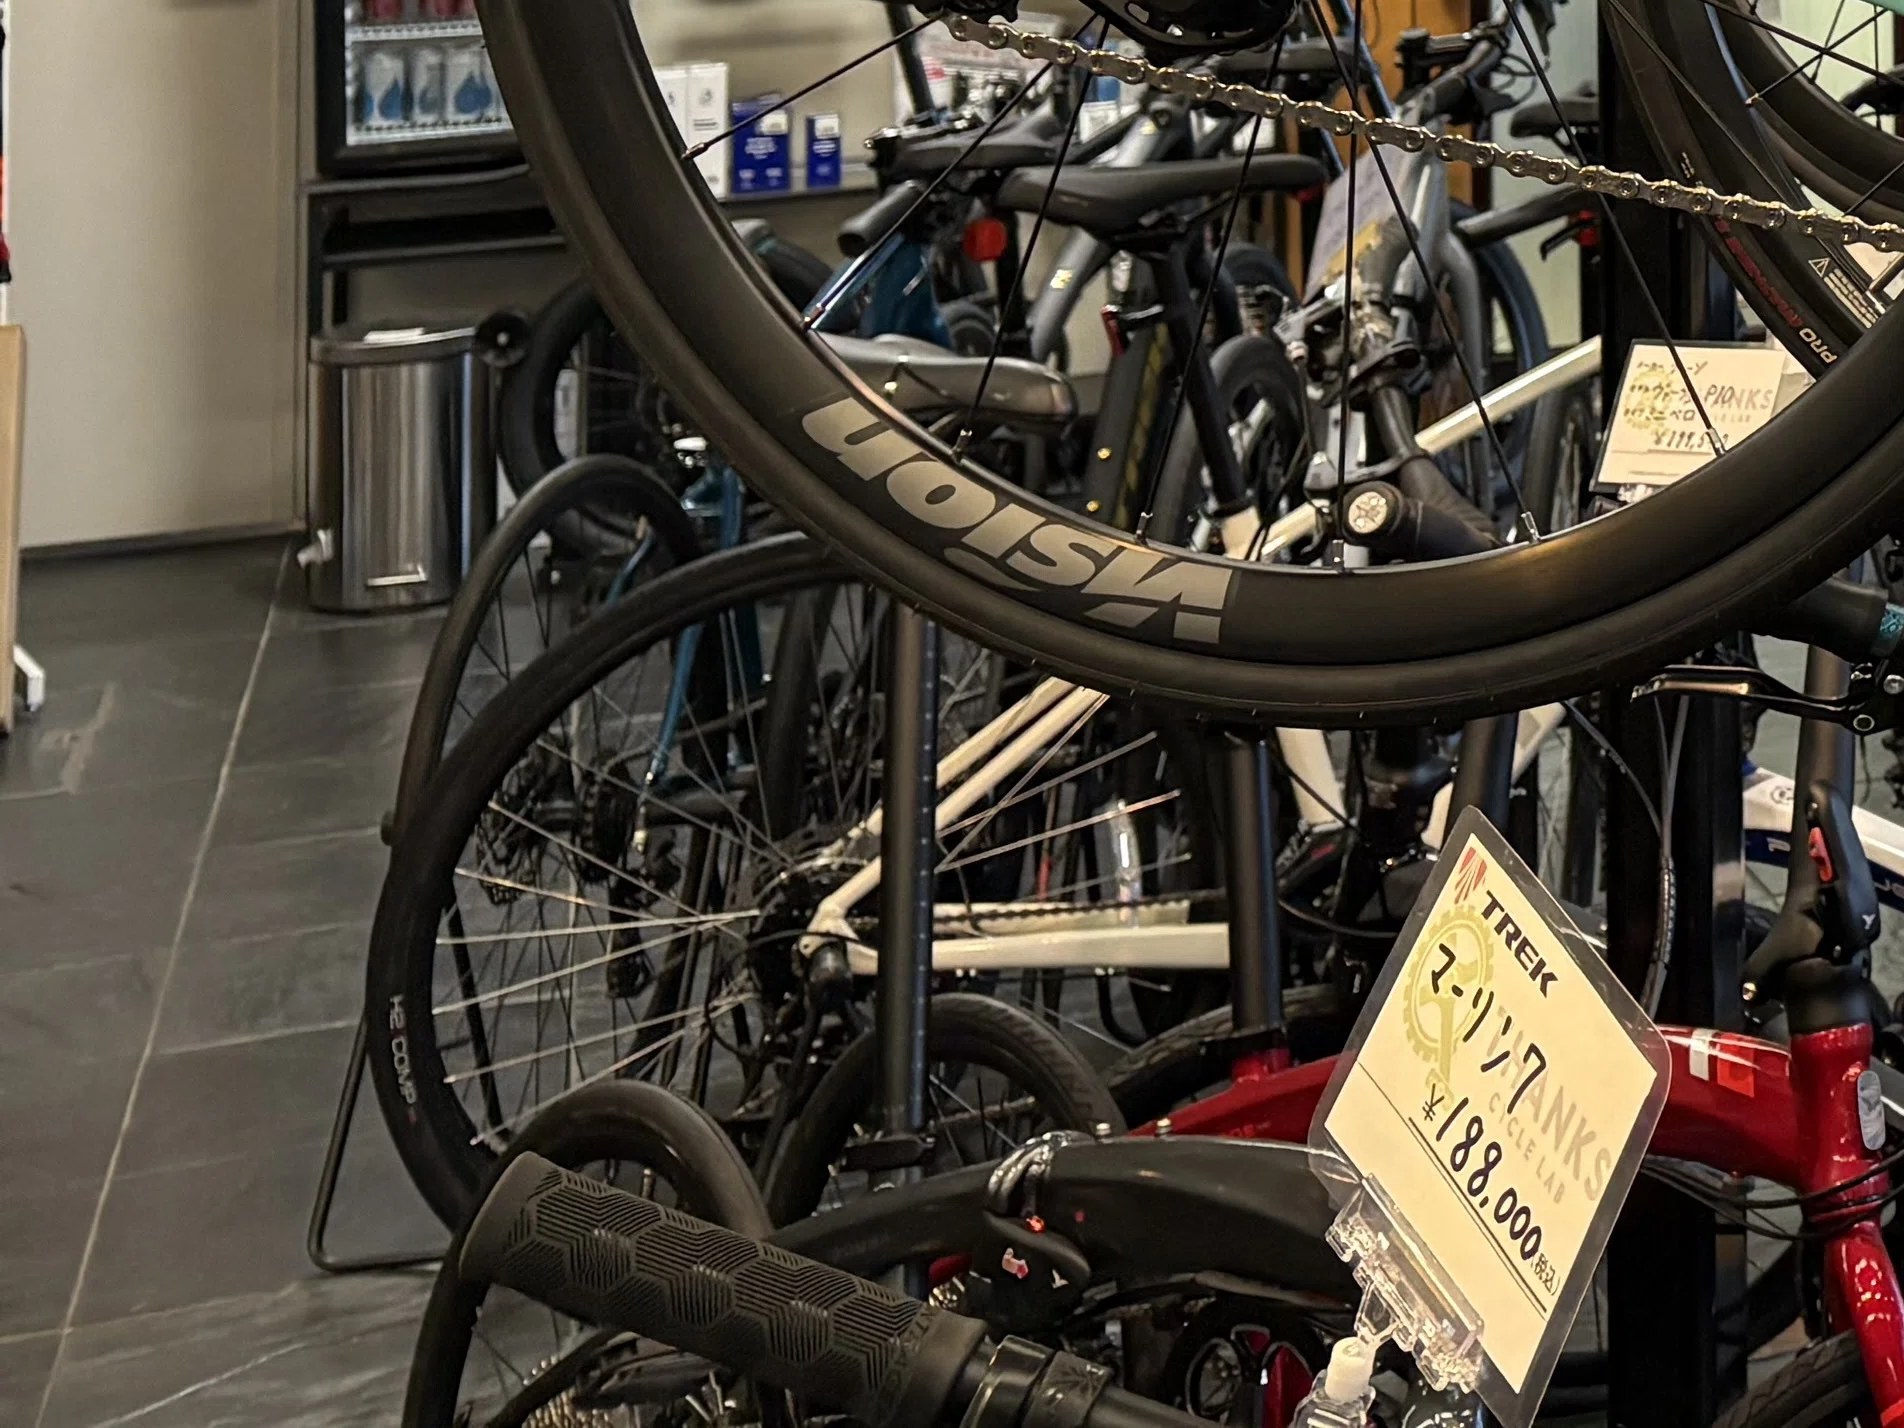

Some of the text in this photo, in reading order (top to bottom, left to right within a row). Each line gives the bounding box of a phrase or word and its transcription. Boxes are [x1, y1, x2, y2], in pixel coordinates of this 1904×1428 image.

[1799, 327, 1838, 365] PRO
[1479, 889, 1560, 999] TREK
[1488, 1090, 1567, 1206] CYCLE LAB
